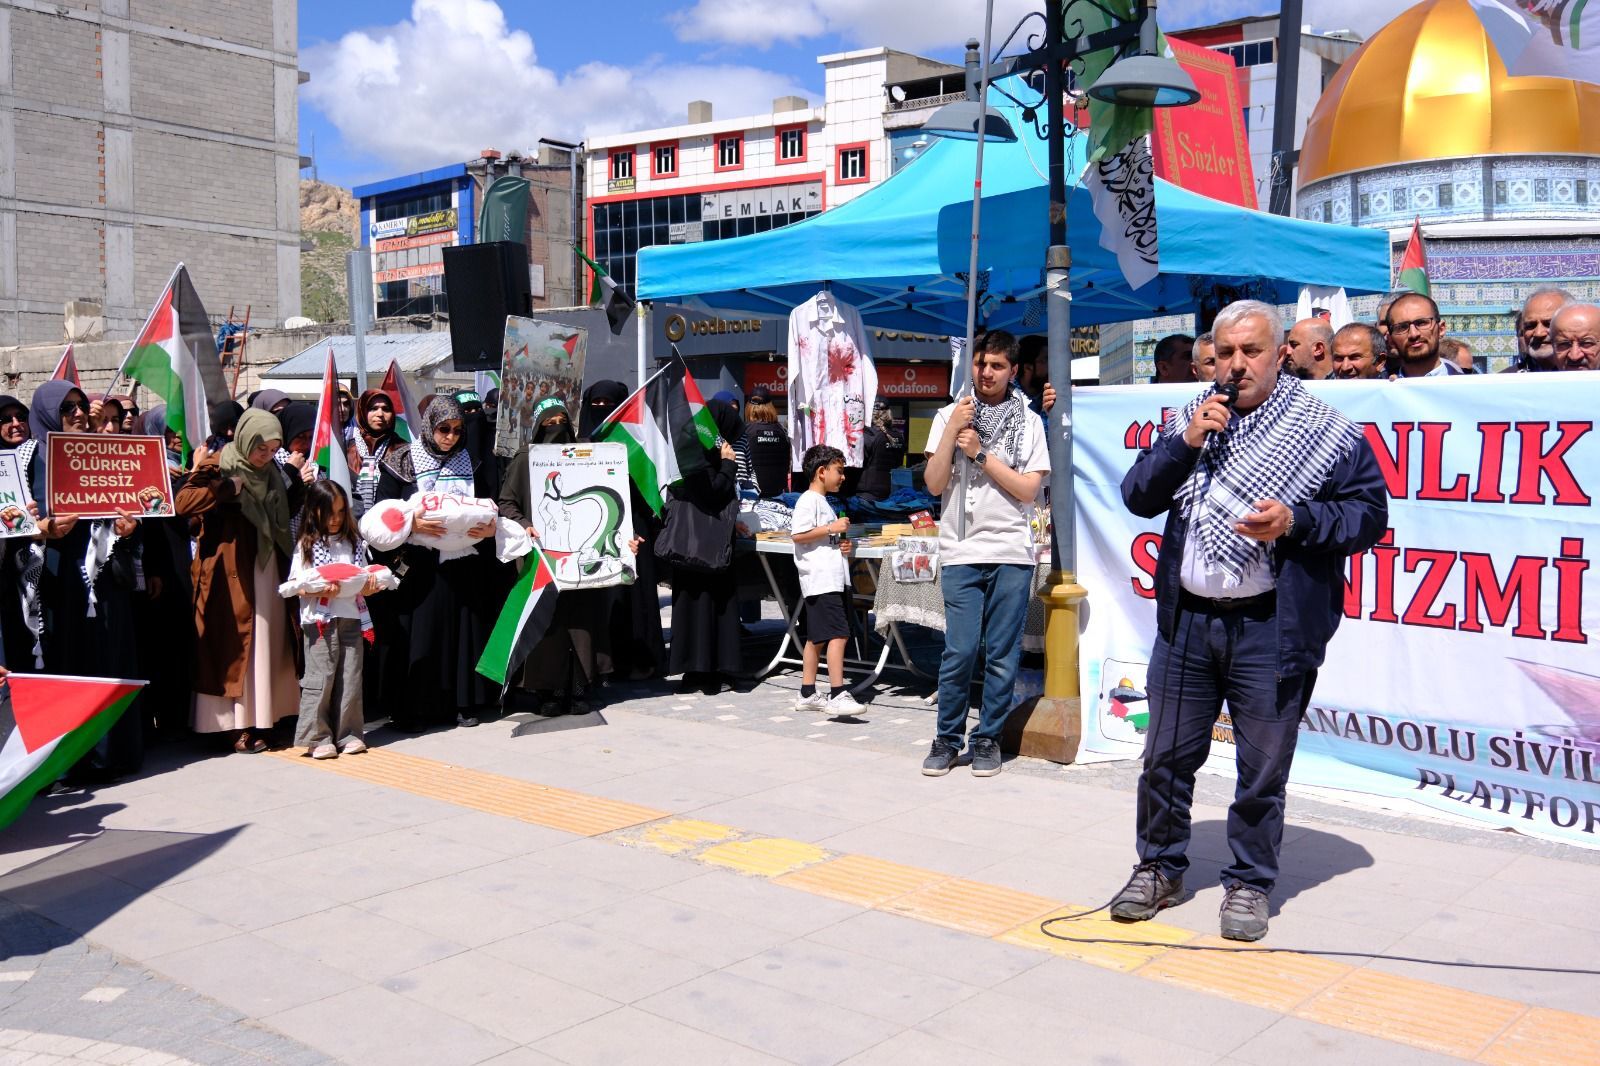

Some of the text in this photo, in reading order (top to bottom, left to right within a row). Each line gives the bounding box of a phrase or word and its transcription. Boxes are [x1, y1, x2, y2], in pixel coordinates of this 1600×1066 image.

[1178, 131, 1234, 176] Sözler
[724, 197, 802, 217] EMLAK
[883, 382, 938, 394] vodafone
[63, 442, 146, 457] ÇOCUKLAR
[70, 456, 141, 471] ÖLÜRKEN
[79, 473, 134, 487] SESSİZ
[54, 492, 138, 505] KALMAYIN
[1298, 707, 1600, 784] ANADOLU SİVİL
